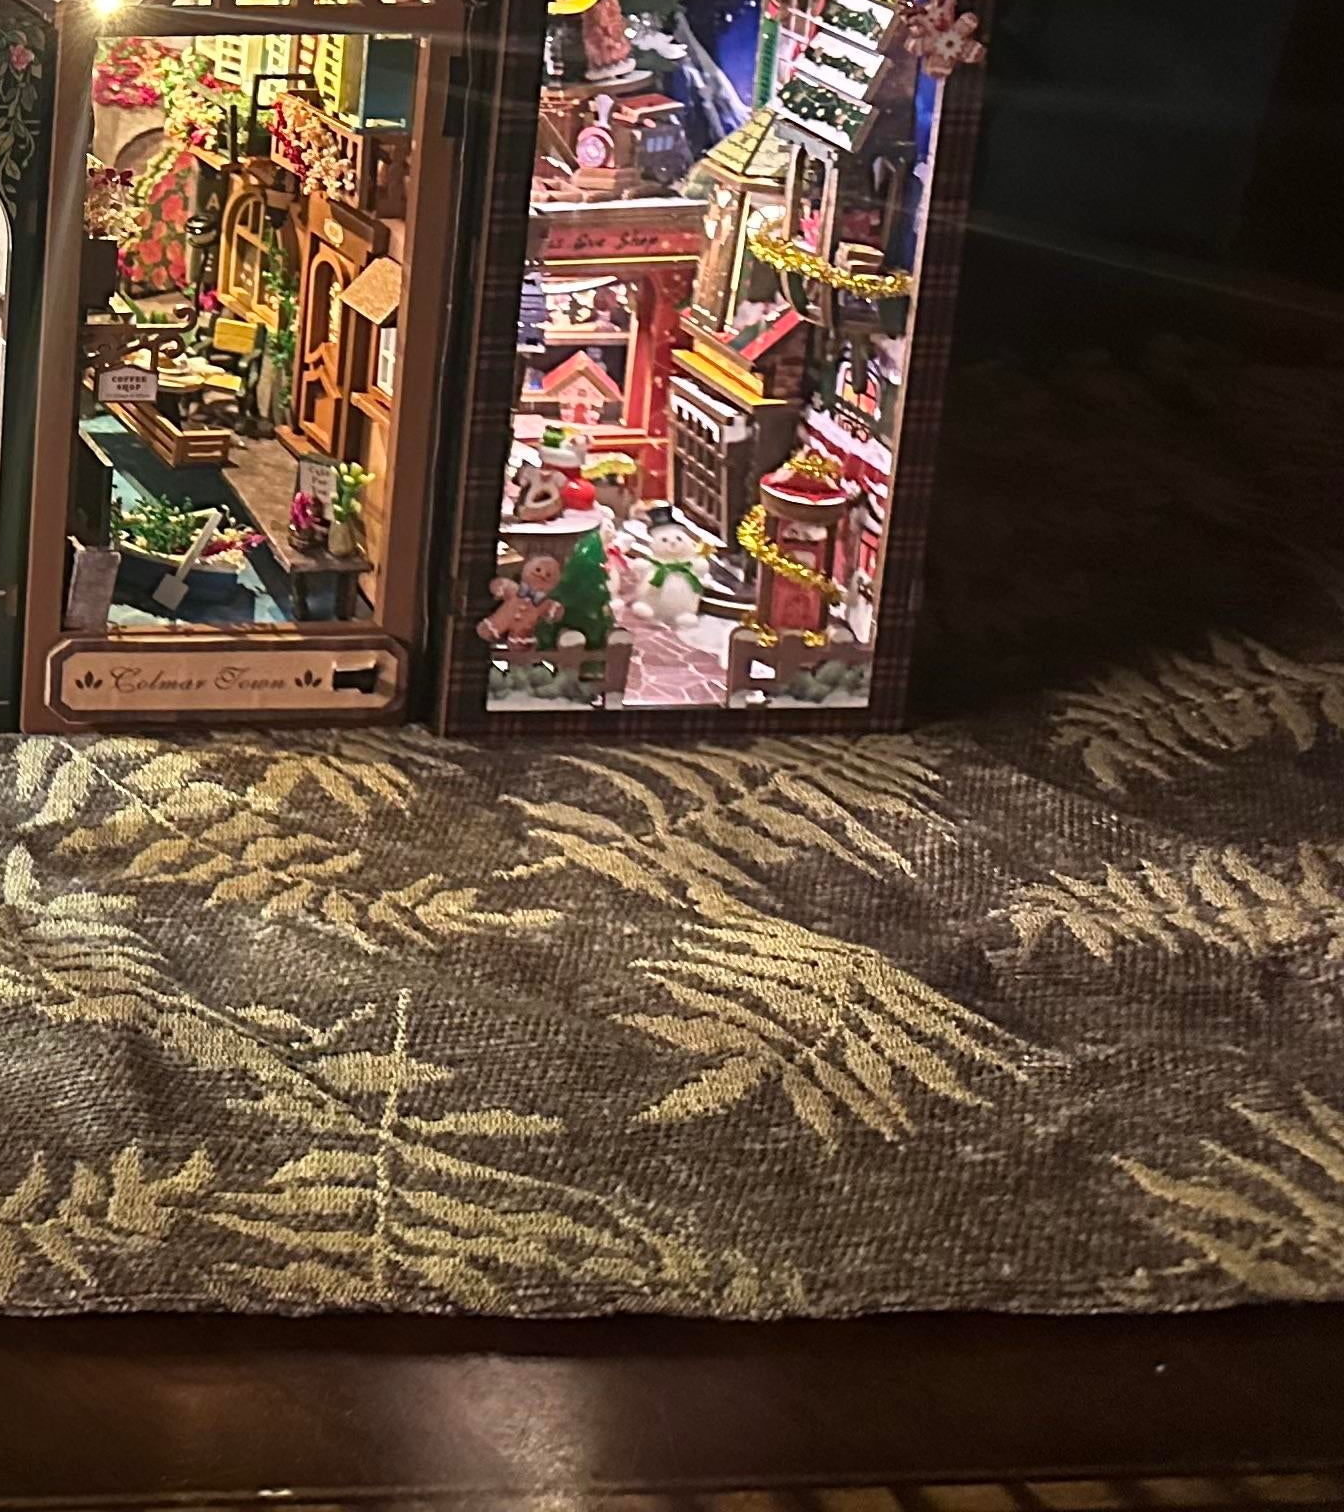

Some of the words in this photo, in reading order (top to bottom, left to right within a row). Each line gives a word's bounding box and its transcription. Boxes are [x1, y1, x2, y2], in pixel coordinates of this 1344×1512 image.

[111, 375, 147, 383] COFFEE
[116, 384, 141, 393] SHOP
[109, 666, 208, 694] Colmar
[214, 666, 287, 691] Town
